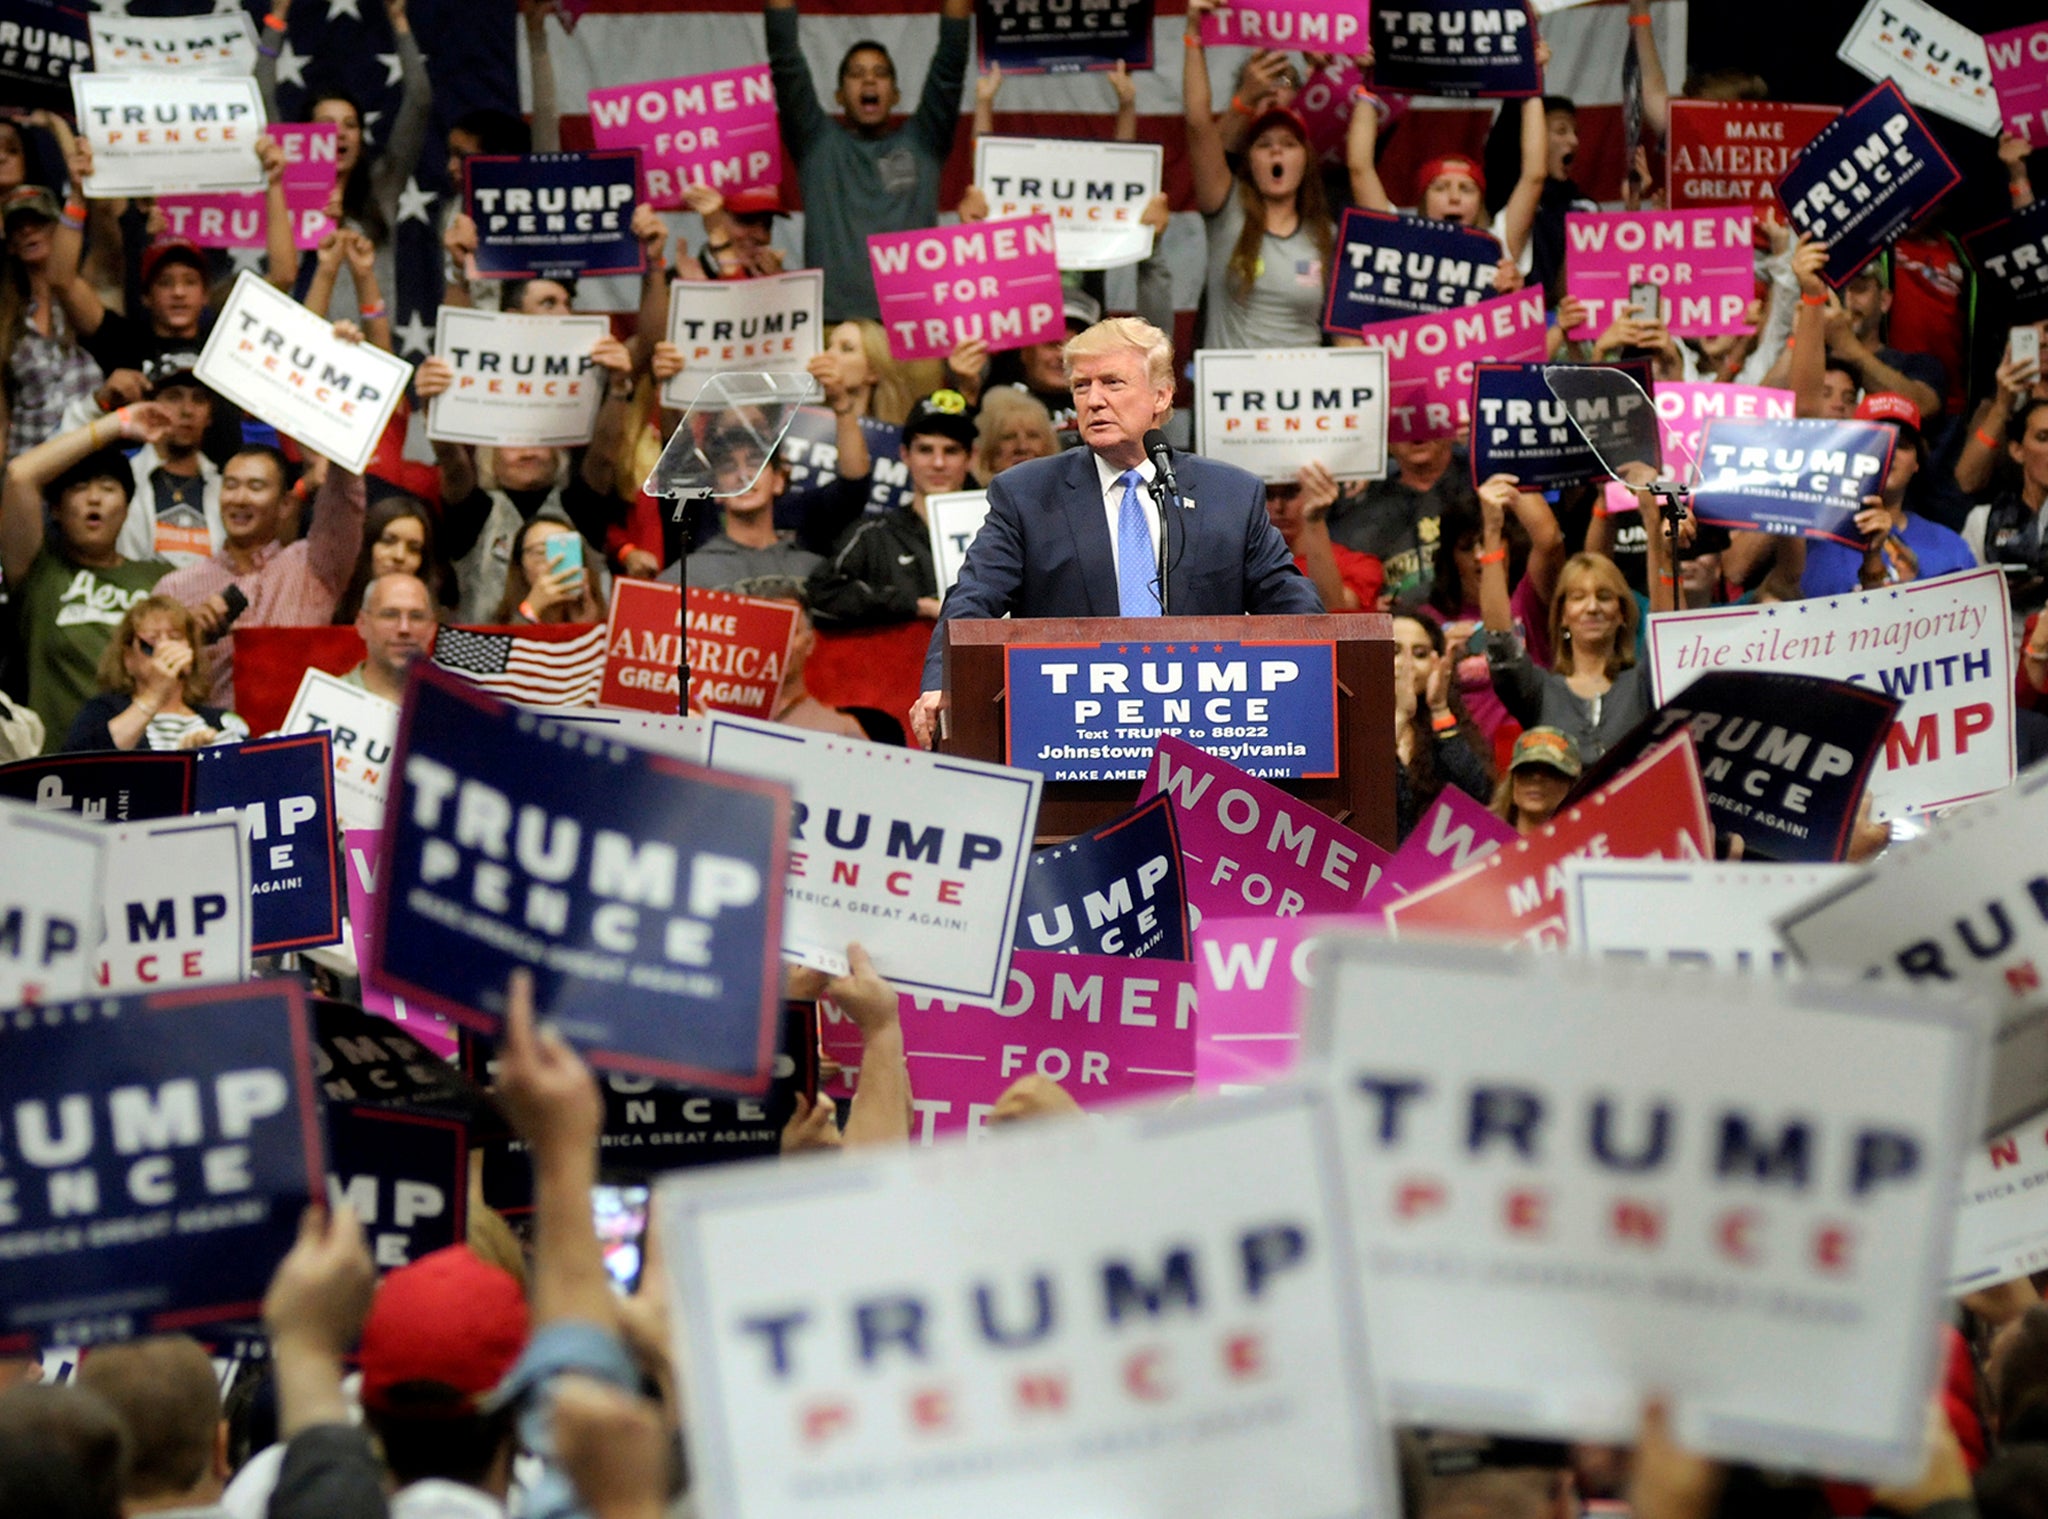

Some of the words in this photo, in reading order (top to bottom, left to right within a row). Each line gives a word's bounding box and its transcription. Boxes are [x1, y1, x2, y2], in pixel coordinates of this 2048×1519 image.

[1215, 8, 1359, 44] TRUMP
[1378, 9, 1528, 36] TRUMP
[0, 21, 91, 63] RUMP
[98, 31, 245, 52] TRUMP
[114, 48, 232, 64] PENCE
[1392, 35, 1518, 54] PENCE
[1880, 8, 1994, 88] TRUM
[1878, 31, 1987, 97] PENCE
[93, 104, 250, 126] TRUMP
[592, 74, 773, 130] WOMEN
[108, 126, 236, 145] PENCE
[655, 127, 720, 156] FOR
[1725, 121, 1784, 141] MAKE
[645, 151, 773, 198] RUMP
[1673, 145, 1800, 175] AMERI
[1792, 113, 1910, 227] TRUMP
[475, 183, 634, 214] TRUMP
[992, 176, 1146, 201] TRUMP
[1684, 178, 1764, 199] GREAT
[1811, 145, 1914, 238] PENCE
[167, 206, 326, 240] TRUP
[489, 211, 620, 233] PENCE
[1569, 216, 1751, 252] WOMEN
[871, 222, 1056, 275] WOMEN
[1628, 262, 1693, 285] FOR
[933, 275, 999, 306] FOR
[683, 310, 809, 342] TRUMP
[893, 303, 1054, 350] TRUMP
[1365, 295, 1545, 359] WOMEN
[239, 309, 381, 403] TRUMP
[450, 346, 598, 376] TRUMP
[693, 336, 795, 361] PENCE
[238, 338, 357, 417] PENCE
[460, 376, 582, 397] PENCE
[1213, 388, 1374, 411] TRUMP
[1480, 394, 1643, 427] TRUMP
[1655, 391, 1794, 419] OMEN
[1226, 415, 1358, 433] PENCE
[1710, 445, 1881, 478] TRUMP
[675, 609, 738, 637] MAKE
[1677, 634, 1732, 669] the
[1735, 624, 1836, 664] silent
[1848, 597, 1988, 656] majority
[610, 628, 781, 683] AMERICA
[1878, 647, 1993, 697] WITH
[698, 679, 766, 708] AGAIN
[1041, 661, 1300, 694] TRUMP
[1075, 698, 1269, 724] PENCE
[308, 712, 392, 765] TRU
[1076, 729, 1109, 740] Text
[1189, 729, 1206, 739] to
[1212, 727, 1269, 739] 88022
[1037, 745, 1154, 760] Johnstown
[1055, 769, 1098, 780] MAKE
[1103, 769, 1147, 780] AMER
[1246, 767, 1291, 779] GAIN!
[1708, 792, 1753, 817] GREAT
[1754, 811, 1809, 839] AGAIN!
[405, 754, 763, 919] TRUMP
[251, 876, 302, 895] AGAIN!
[789, 851, 966, 906] ENCE
[1210, 856, 1305, 918] FOR
[420, 837, 716, 967] PENCE
[784, 887, 842, 910] MERICA
[847, 899, 902, 921] GREAT
[907, 911, 968, 934] AGAIN!
[1027, 854, 1169, 947] UMP
[1001, 1045, 1110, 1086] FOR
[14, 1067, 289, 1168] UMP
[626, 1099, 776, 1125] NCE
[649, 1130, 707, 1145] GREAT
[713, 1128, 776, 1143] AGAIN!
[1354, 1074, 1926, 1196] TRUMP
[738, 1224, 1307, 1378] TRUMP
